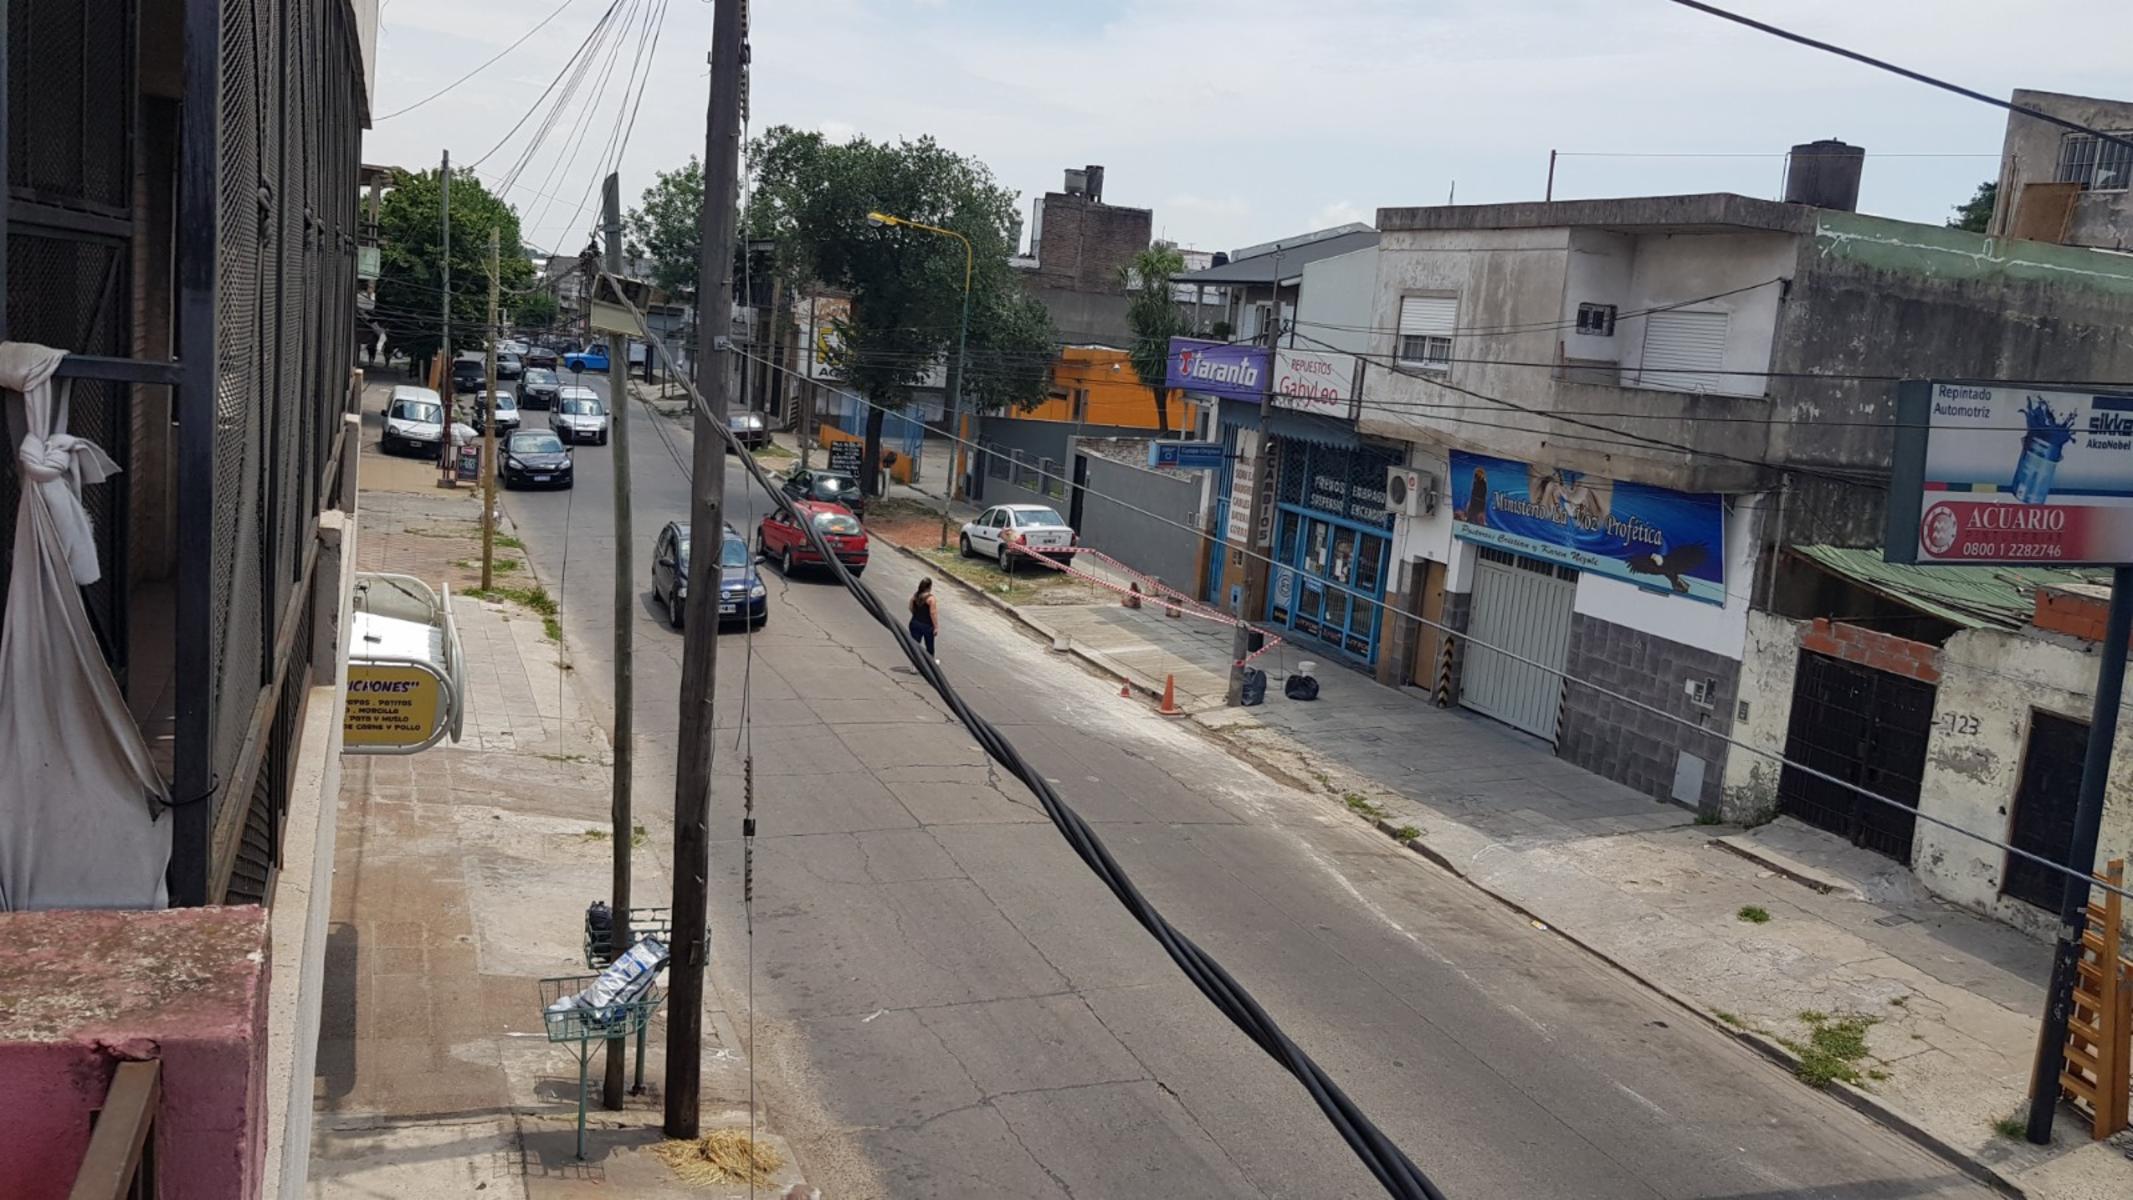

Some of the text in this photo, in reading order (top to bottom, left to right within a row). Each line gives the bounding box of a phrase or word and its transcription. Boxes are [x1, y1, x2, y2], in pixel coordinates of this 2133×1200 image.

[1291, 358, 1332, 376] REPUESTOS
[1280, 376, 1338, 407] GabyLeo
[1938, 384, 1992, 401] Repintado
[1933, 402, 1991, 418] Automotriz
[2085, 438, 2132, 450] AkzoNobel
[1492, 491, 1663, 546] Ministerio La Voz Profética
[1967, 507, 2065, 530] ACUARIO
[1963, 542, 1995, 556] 0800
[2008, 543, 2062, 558] 2282746
